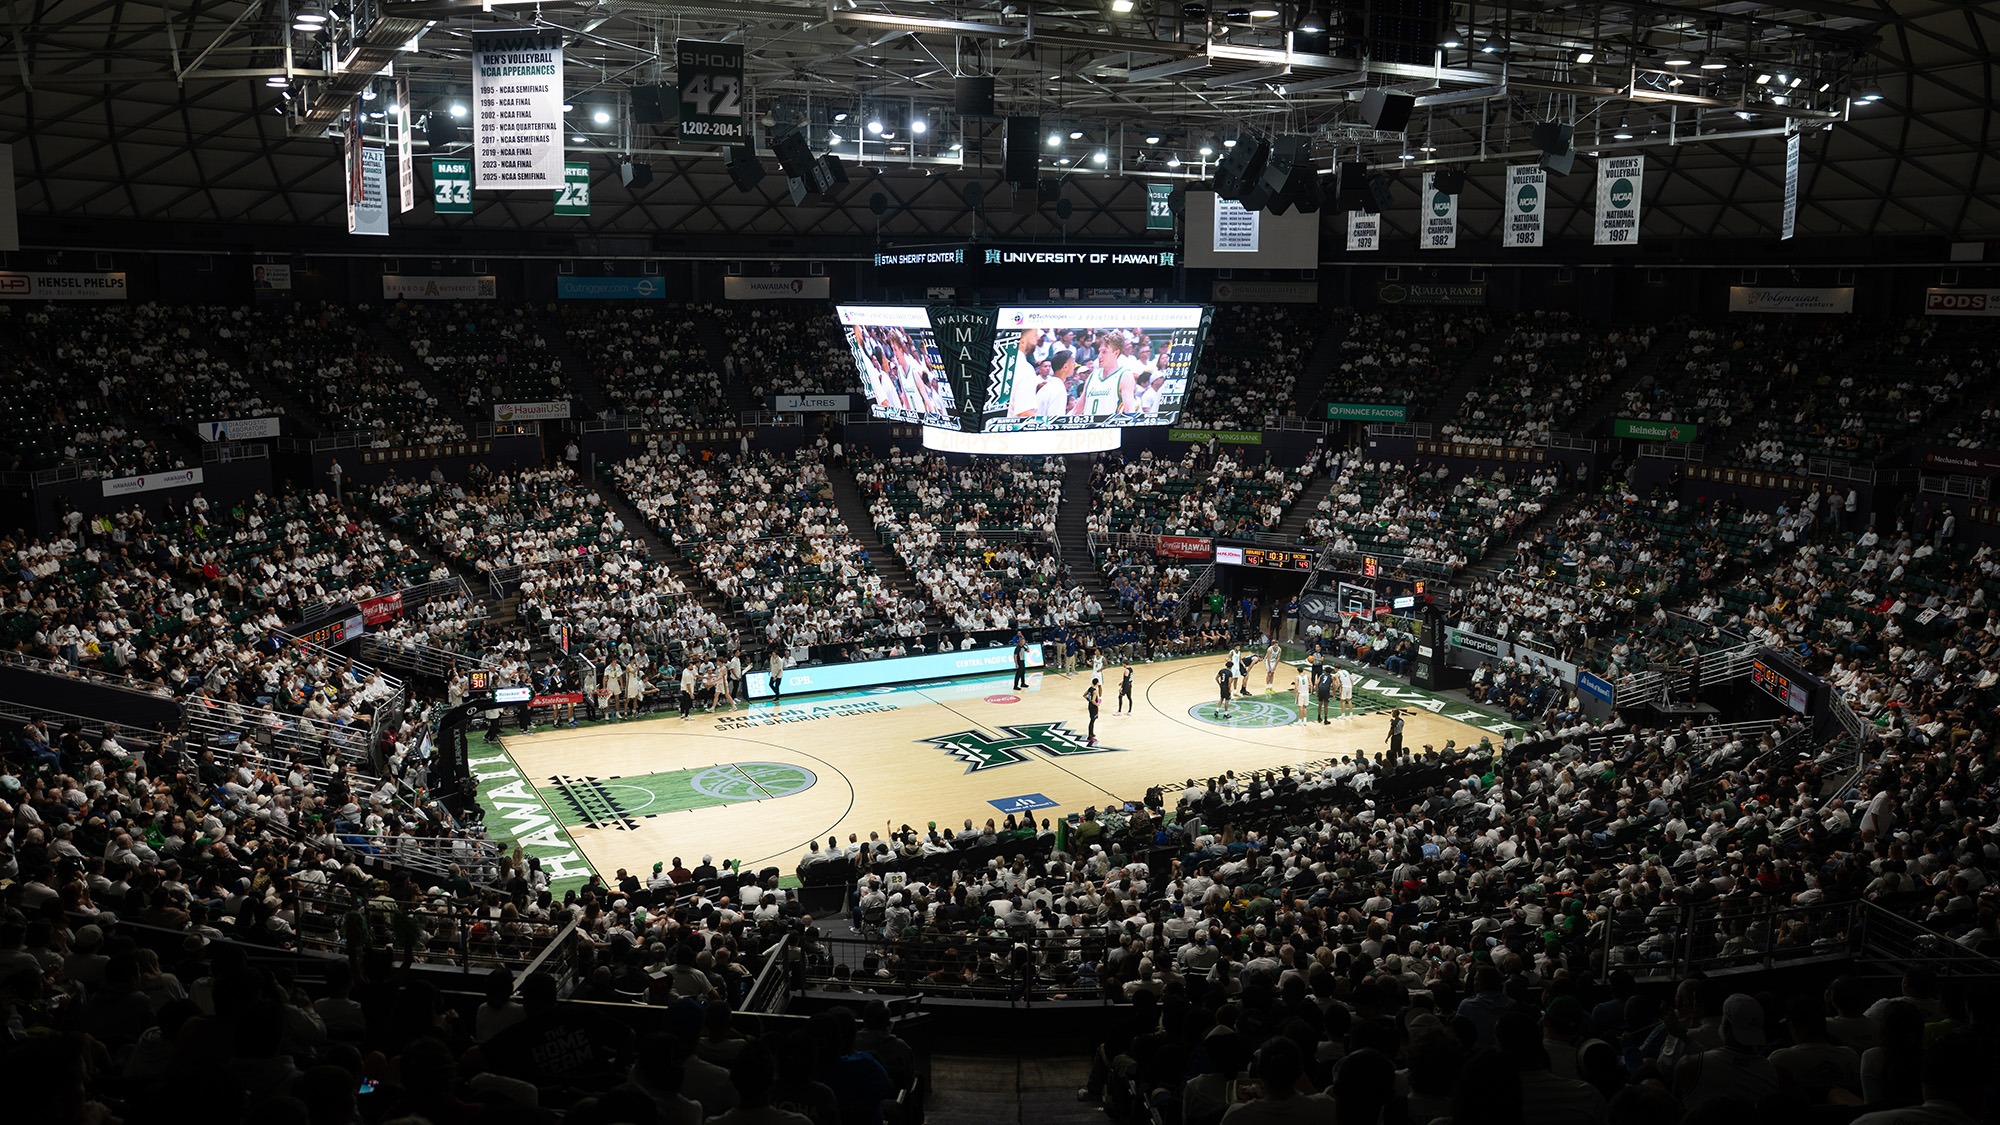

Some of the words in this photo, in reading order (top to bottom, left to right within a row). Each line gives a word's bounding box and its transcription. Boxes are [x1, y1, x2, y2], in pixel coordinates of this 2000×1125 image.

[483, 54, 506, 65] MEN'S
[507, 53, 553, 64] VOLLEYBALL
[681, 53, 741, 68] SHOJI
[481, 67, 502, 78] NCAA
[502, 65, 556, 76] APPEARANCES
[480, 86, 495, 94] 1995
[516, 85, 549, 93] SEMIFINALS
[681, 74, 742, 117] 42
[681, 121, 743, 137] 1,202-204-1
[1610, 158, 1638, 168] WOMEN'S
[1516, 168, 1542, 176] WOMEN'S
[1606, 168, 1640, 178] VOLLEYBALL
[1512, 175, 1544, 184] VOLLEYBALL
[435, 180, 471, 204] 33
[555, 182, 589, 206] 23
[1612, 193, 1633, 202] NCAA
[1150, 202, 1170, 216] 32
[1606, 210, 1634, 219] NATIONAL
[1430, 218, 1452, 226] NATIONAL
[1514, 214, 1539, 222] NATIONAL
[1604, 219, 1635, 228] CHAMPION
[1428, 226, 1454, 234] CHAMPION
[1512, 222, 1540, 232] CHAMPION
[1354, 229, 1376, 237] CHAMPION
[1516, 232, 1535, 244] 1983
[1608, 230, 1629, 242] 1987
[1358, 238, 1372, 248] 1979
[1432, 235, 1448, 246] 1982
[882, 256, 898, 264] STAN
[898, 254, 926, 264] SHERIFF
[926, 252, 954, 262] CENTER
[1004, 252, 1084, 263] UNIVERSITY
[1090, 254, 1108, 263] OF
[38, 278, 82, 288] HENSEL
[84, 278, 124, 288] PHELPS
[565, 283, 629, 293] Outrigger.com
[1410, 286, 1448, 296] KUALOA
[1450, 287, 1482, 296] RANCH
[1760, 291, 1818, 306] Polynesian
[1929, 295, 1984, 308] PODS
[937, 314, 989, 326] WAIKIKI
[956, 328, 976, 412] MALIA
[514, 404, 567, 414] HawaiiUSA
[1092, 399, 1099, 414] 0
[1340, 408, 1370, 416] FINANCE
[1372, 409, 1404, 417] FACTORS
[1068, 415, 1094, 424] 10:31
[1629, 424, 1667, 436] Heineken
[940, 430, 1009, 452] ZIPPY'S
[1056, 430, 1114, 451] ZIPPY'S
[1934, 455, 1963, 465] Mechanics
[1964, 458, 1978, 467] Bank
[1268, 552, 1288, 561] 10:31
[1452, 635, 1498, 653] enterprise
[790, 675, 814, 686] CPB.
[956, 658, 982, 668] CENTRAL
[984, 655, 1007, 665] PACIFIC
[1221, 673, 1226, 682] 3
[473, 680, 484, 688] 30
[717, 708, 800, 724] Bankoh
[812, 700, 880, 713] Arena
[714, 719, 759, 732] STAN
[764, 712, 831, 726] SHERIFF
[836, 704, 900, 716] CENTER
[892, 875, 902, 883] 23
[530, 1028, 590, 1063] HOME
[537, 1044, 594, 1074] TEAM
